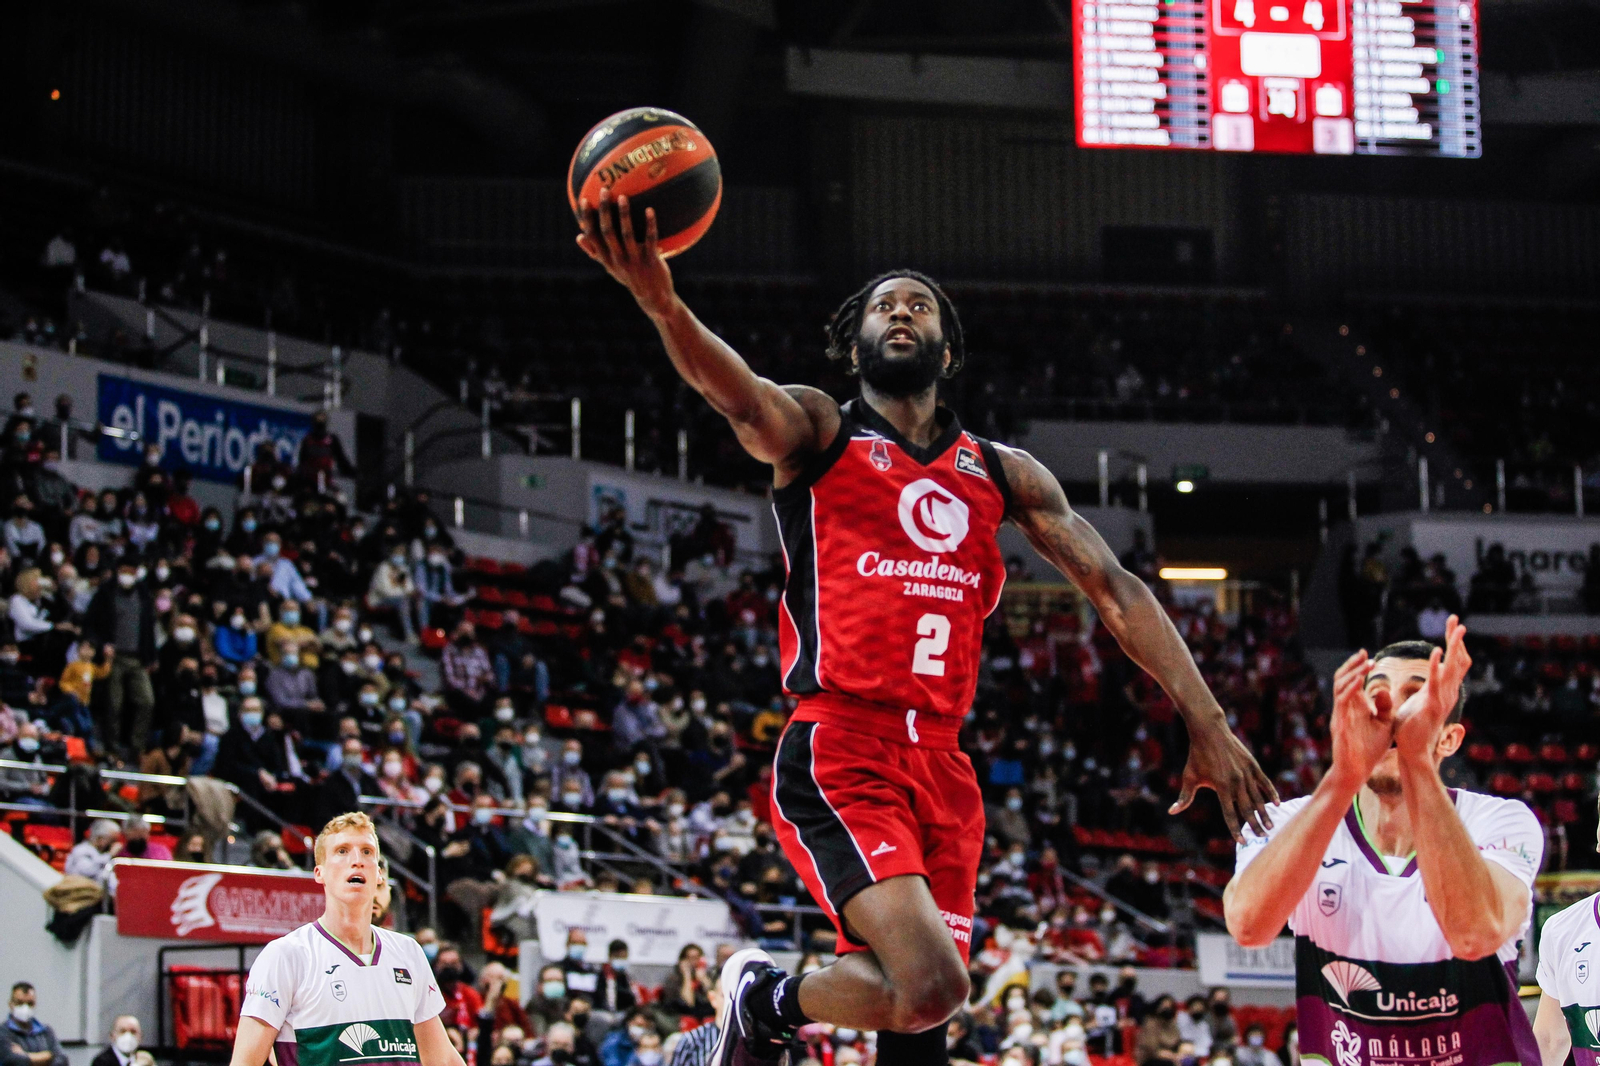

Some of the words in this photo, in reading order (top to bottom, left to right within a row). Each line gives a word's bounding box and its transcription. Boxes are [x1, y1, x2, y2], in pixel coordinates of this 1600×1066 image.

[903, 582, 964, 602] ZARAGOZA
[912, 612, 951, 677] 2
[1376, 987, 1459, 1013] Unicaja
[378, 1037, 417, 1055] Unicaja
[1368, 1031, 1461, 1058] MÁLAGA
